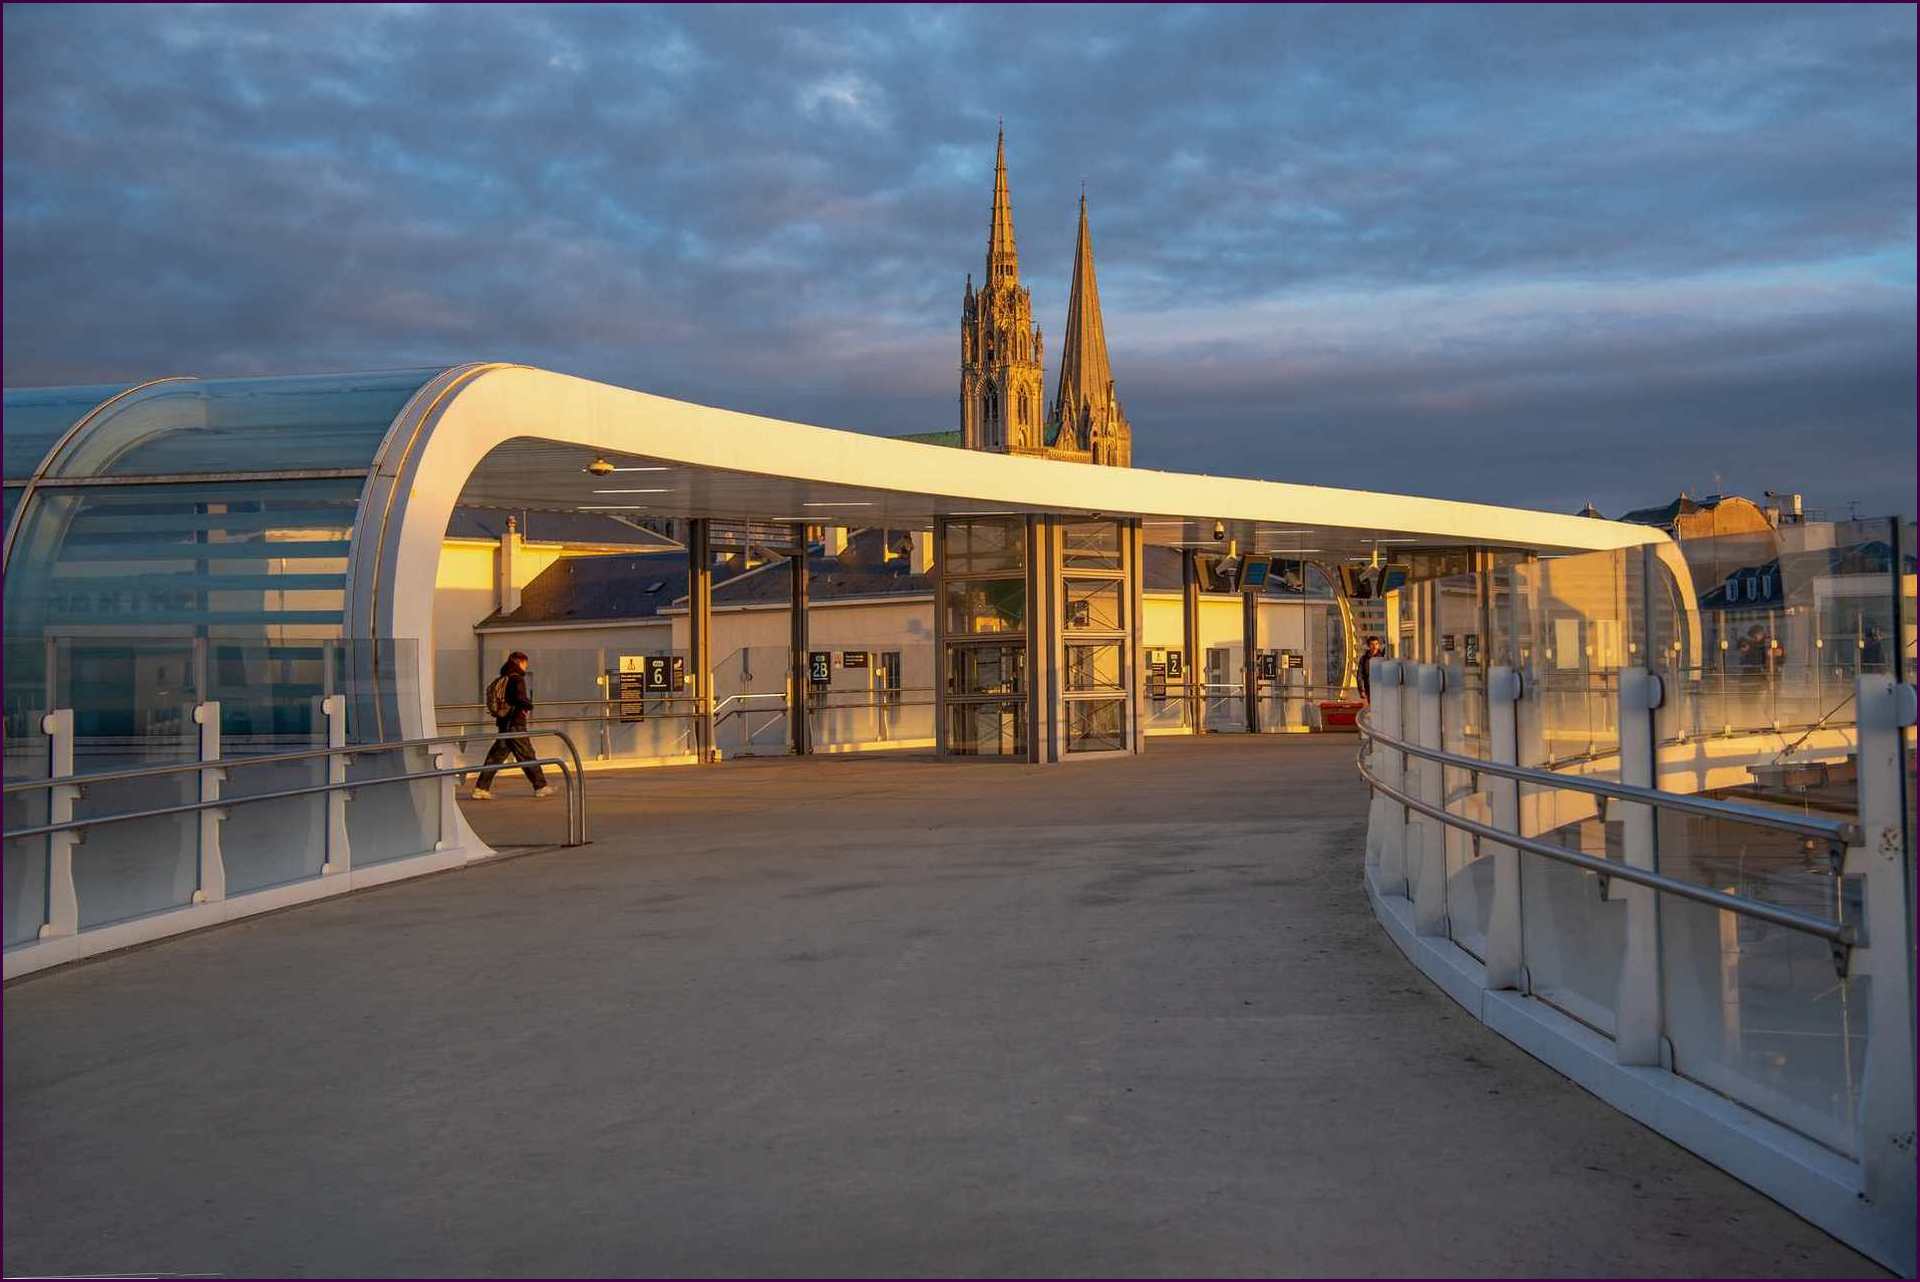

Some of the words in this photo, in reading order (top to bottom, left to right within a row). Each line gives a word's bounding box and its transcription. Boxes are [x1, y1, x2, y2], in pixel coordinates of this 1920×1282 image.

[813, 663, 828, 677] 2B
[1171, 660, 1177, 672] 2
[654, 668, 663, 684] 6
